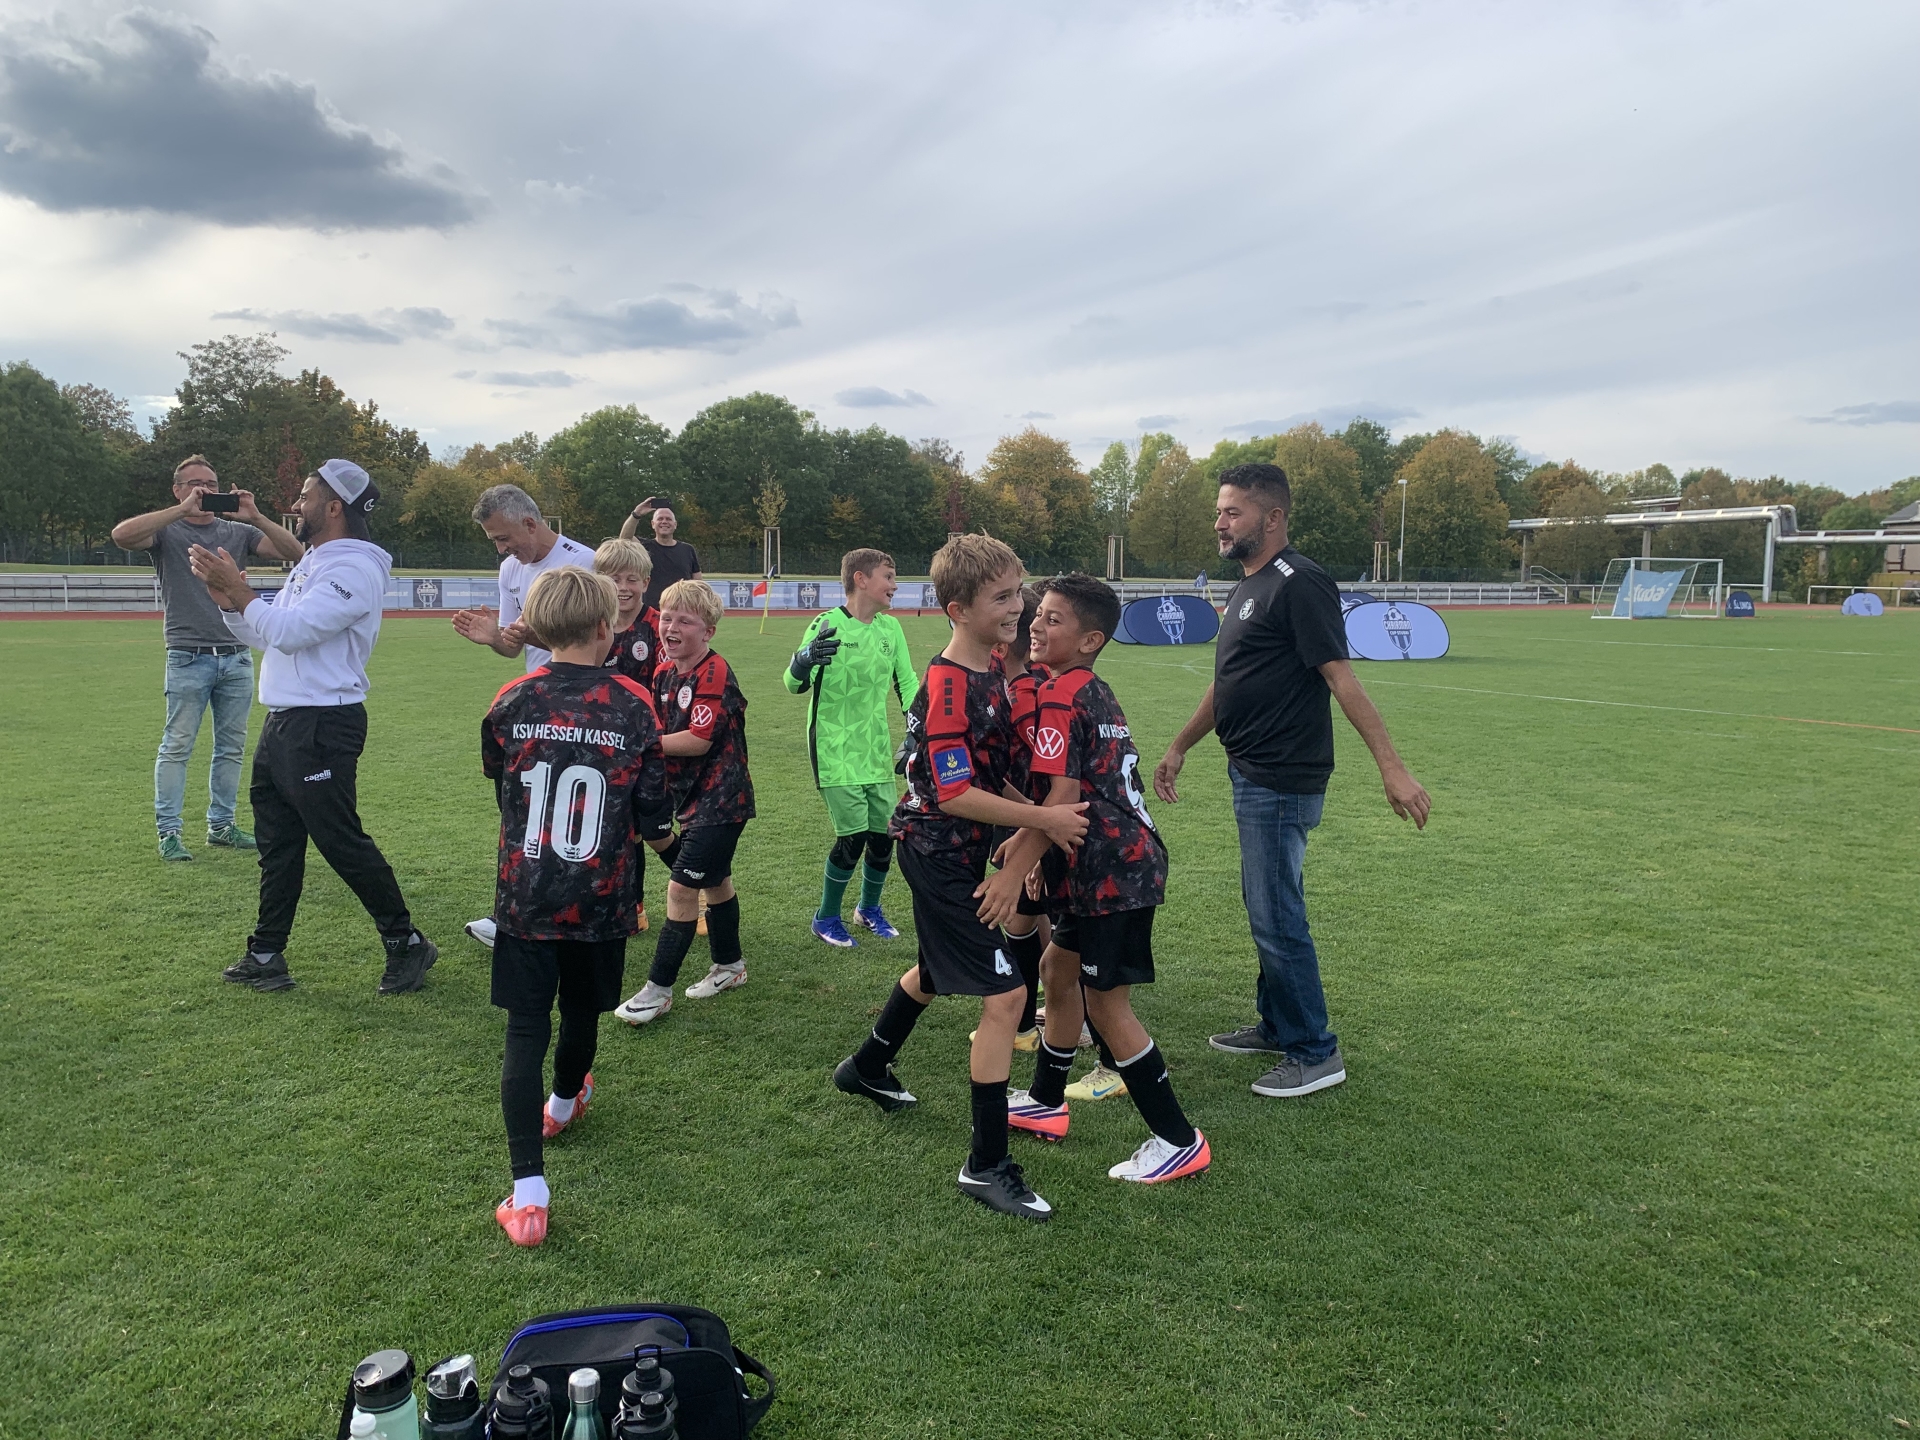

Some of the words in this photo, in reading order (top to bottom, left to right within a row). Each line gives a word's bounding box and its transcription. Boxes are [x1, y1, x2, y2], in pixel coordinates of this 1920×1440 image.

[329, 580, 353, 600] capelli
[513, 723, 534, 739] KSV
[534, 724, 582, 743] HESSEN
[584, 728, 626, 751] KASSEL
[303, 769, 332, 781] capelli
[520, 761, 607, 862] 10
[994, 948, 1013, 976] 4
